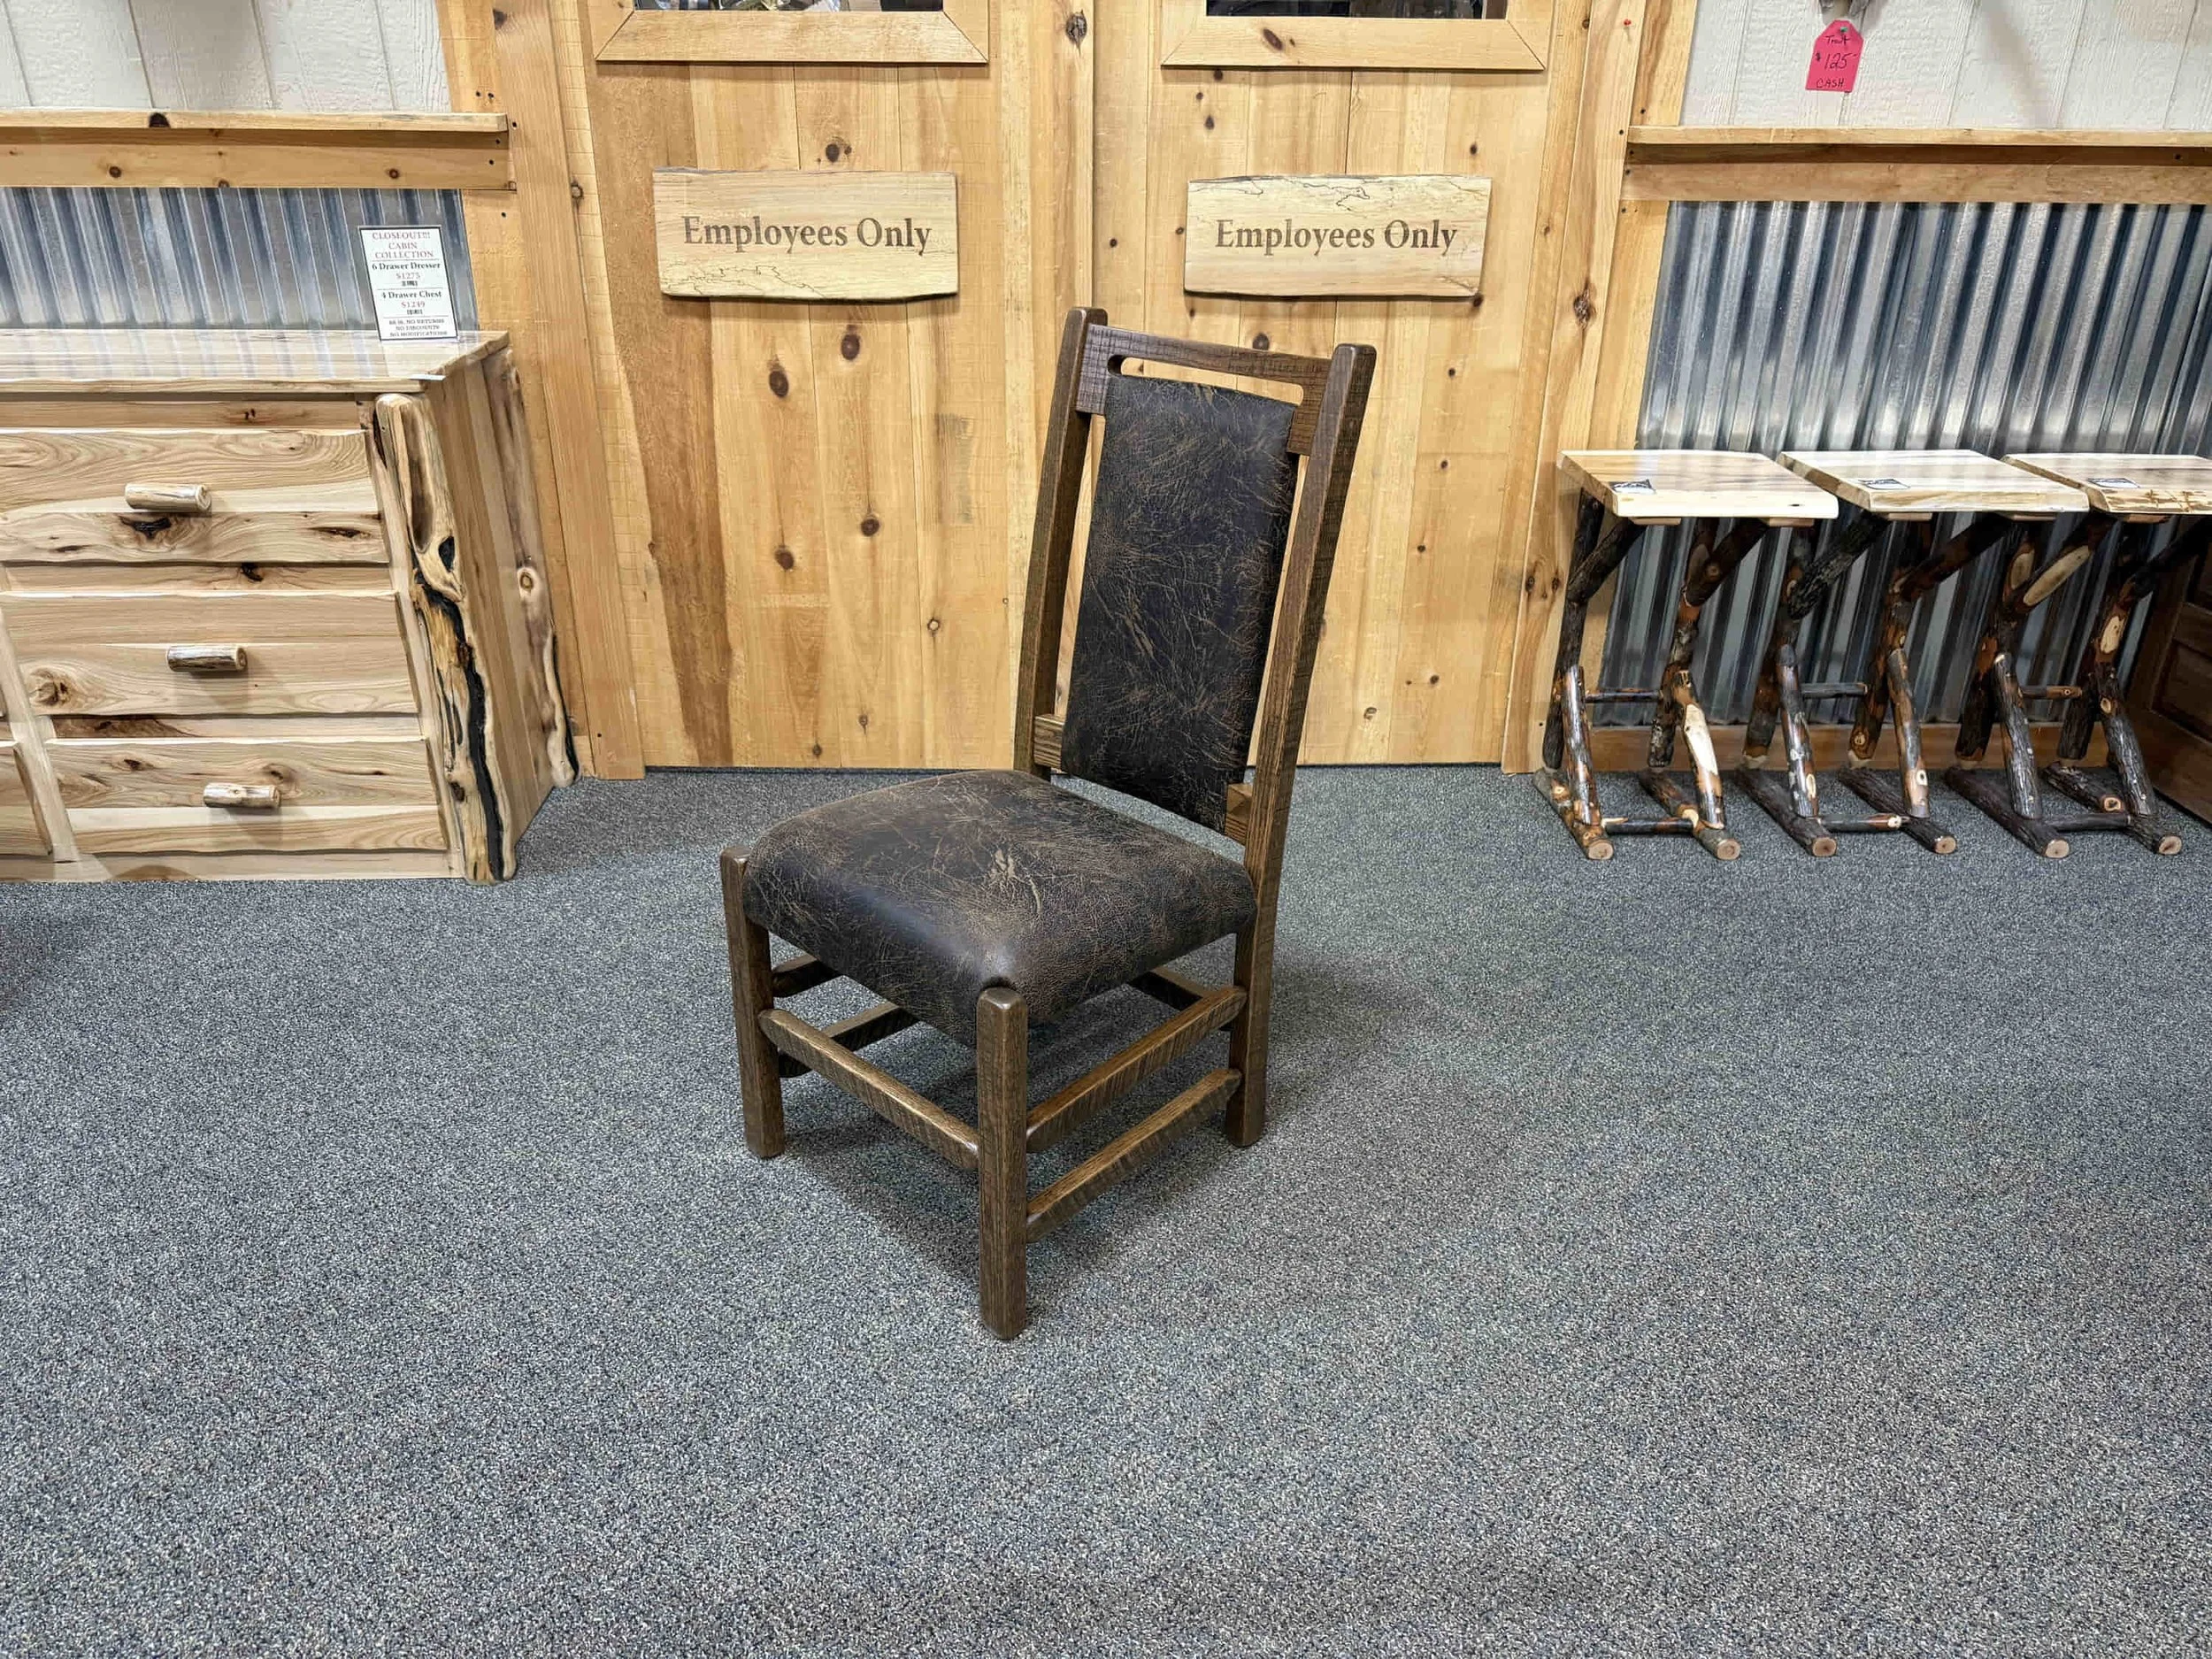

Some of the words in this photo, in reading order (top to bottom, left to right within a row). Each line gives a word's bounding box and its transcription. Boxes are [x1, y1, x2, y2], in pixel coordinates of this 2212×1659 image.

[1816, 78, 1845, 88] CASH
[681, 215, 848, 254] Employees
[856, 217, 932, 257] Only
[1215, 219, 1375, 257] Employees
[1384, 219, 1457, 257] Only
[374, 250, 434, 259] COLLECTION
